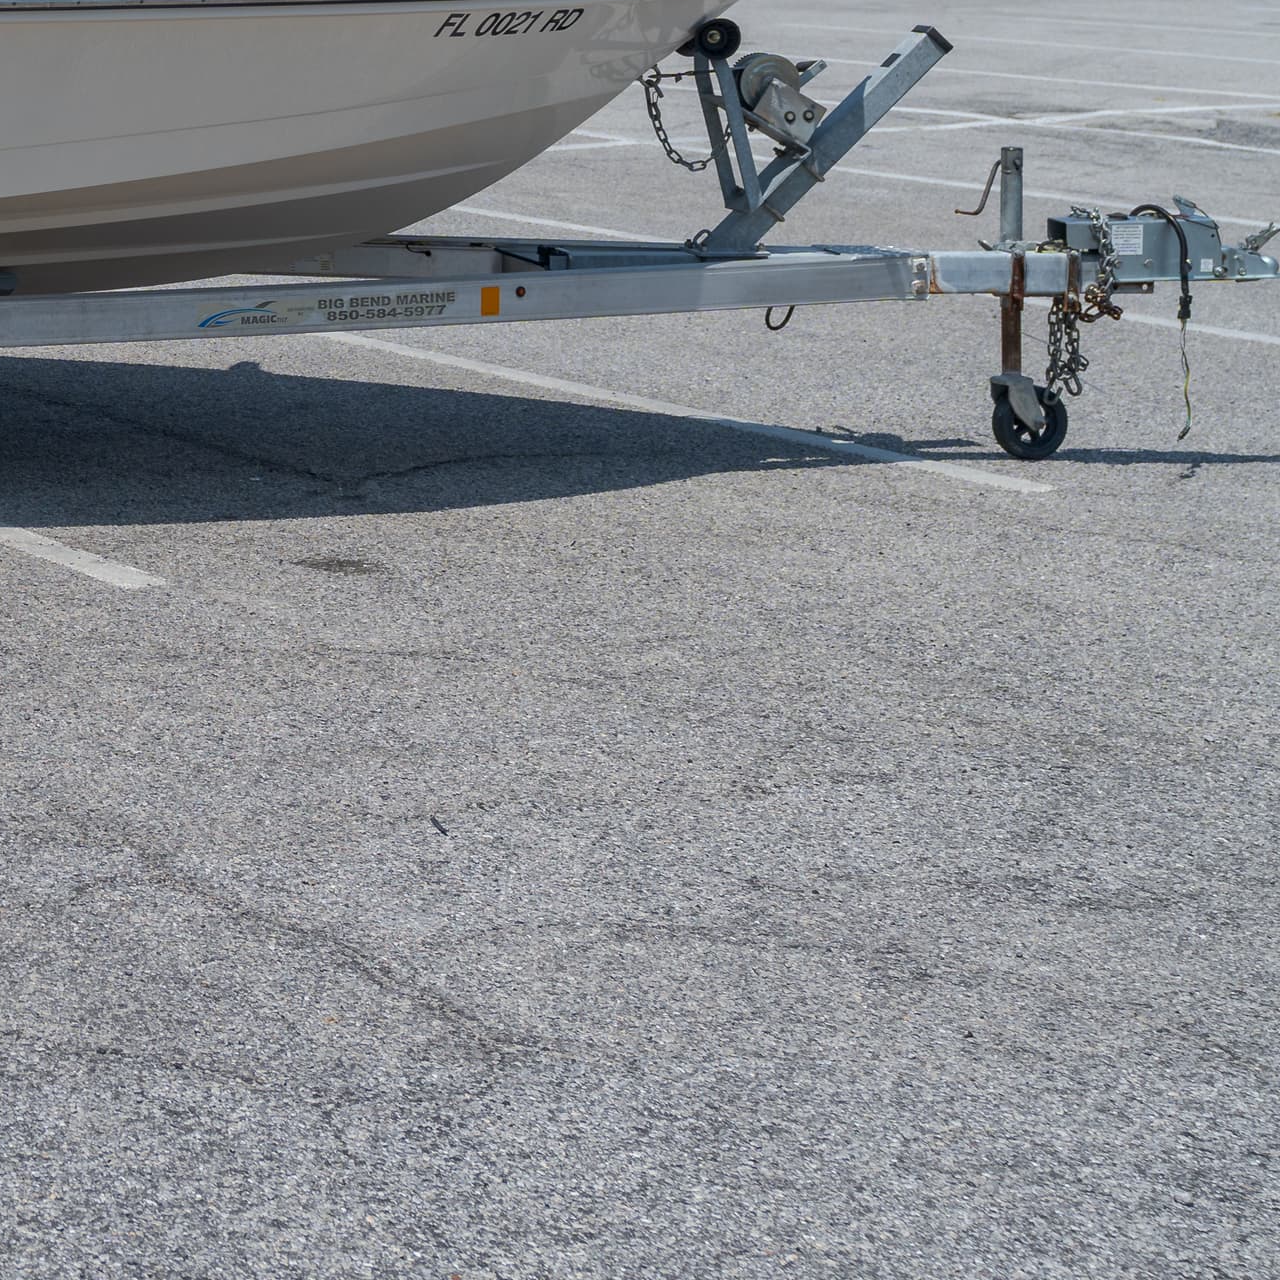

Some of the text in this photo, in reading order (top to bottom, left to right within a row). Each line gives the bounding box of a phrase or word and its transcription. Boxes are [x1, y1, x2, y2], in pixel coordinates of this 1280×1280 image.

[433, 8, 585, 38] FL 0021 RD
[317, 298, 344, 311] BIG
[349, 295, 391, 309] BEND
[395, 291, 456, 306] MARINE
[326, 304, 447, 322] 850-584-5977
